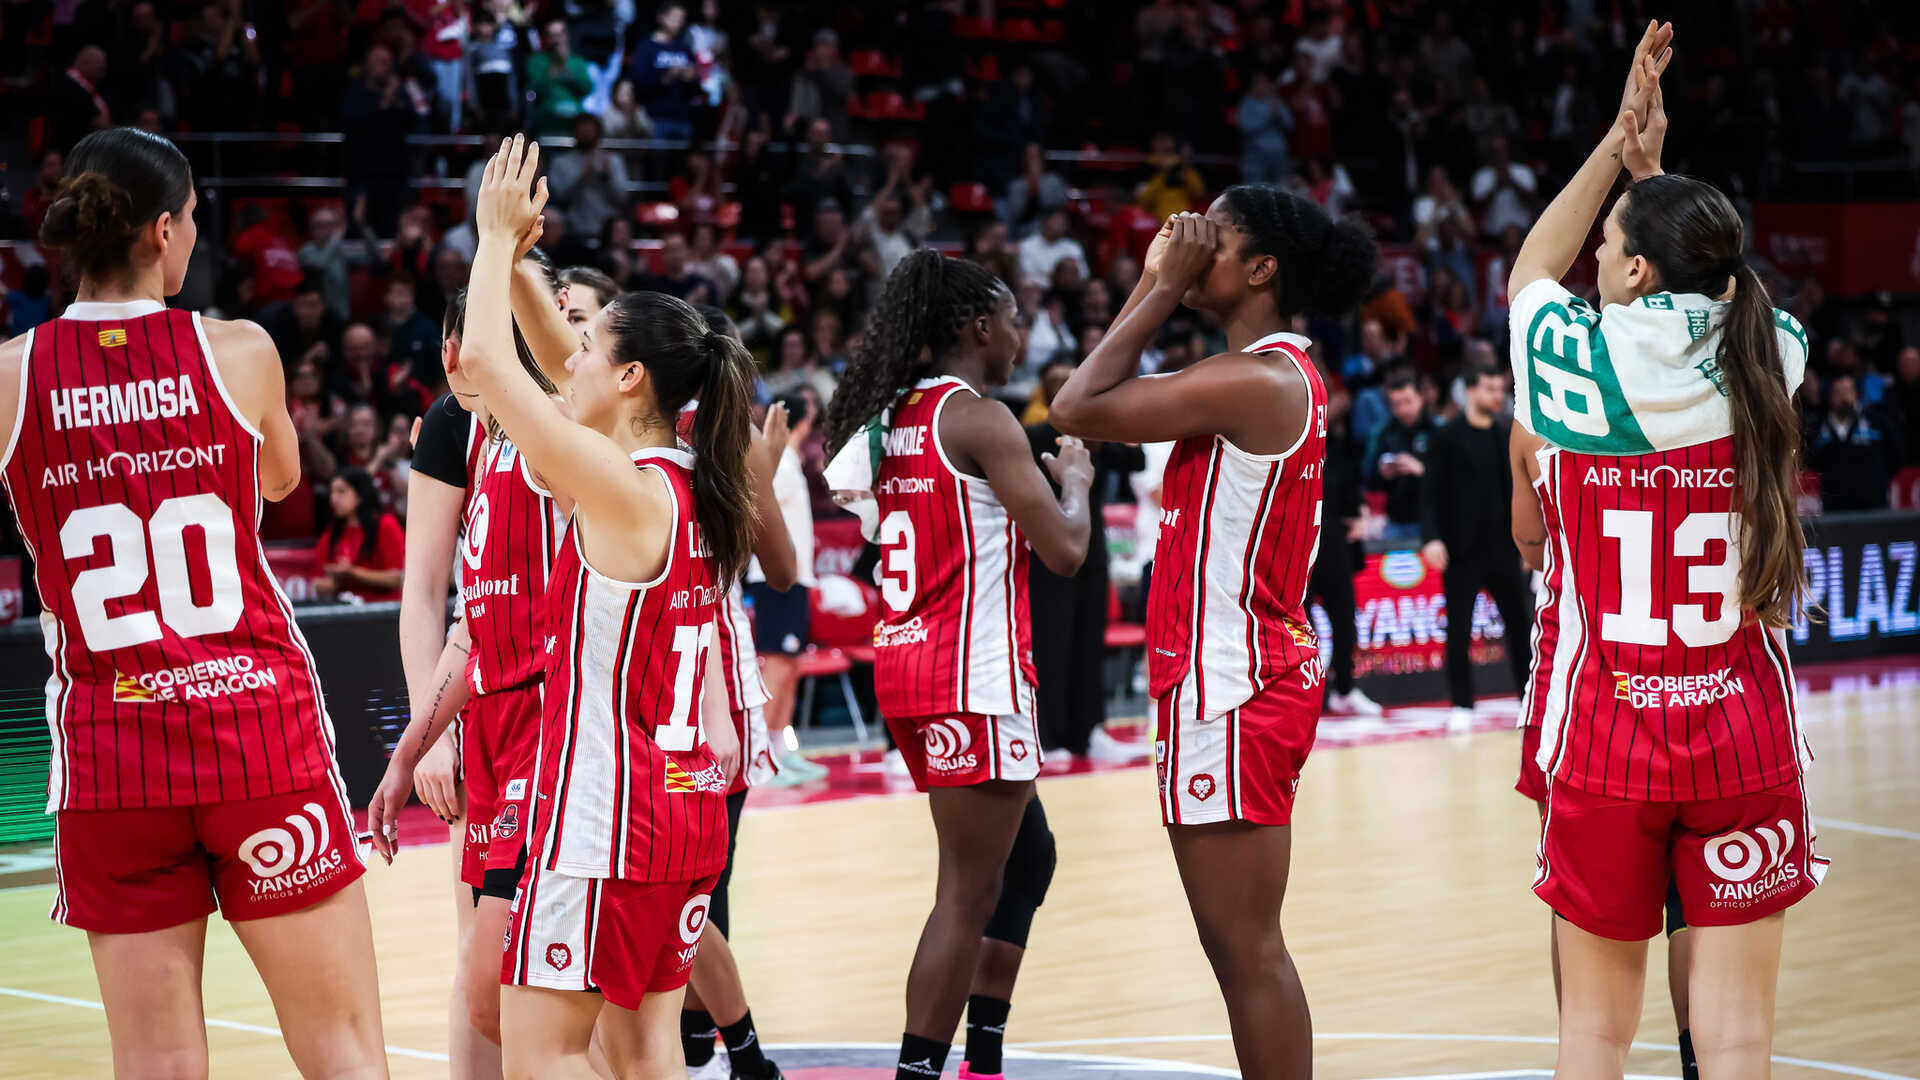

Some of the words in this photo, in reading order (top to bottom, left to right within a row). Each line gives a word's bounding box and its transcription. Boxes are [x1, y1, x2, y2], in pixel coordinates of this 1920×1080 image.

[50, 374, 199, 431] HERMOSA
[42, 465, 78, 489] AIR
[88, 444, 226, 481] HORIZONT
[1583, 467, 1622, 486] AIR
[1631, 465, 1735, 488] HORIZO
[59, 492, 244, 652] 20
[880, 510, 917, 612] 3
[1601, 509, 1742, 648] 13
[669, 590, 690, 611] AIR
[1793, 540, 1920, 645] PLAZ
[139, 655, 253, 691] GOBIERNO
[185, 667, 277, 700] ARAGON
[1631, 691, 1661, 709] DE
[247, 848, 342, 895] YANGUAS
[1709, 862, 1799, 900] YANGUAS
